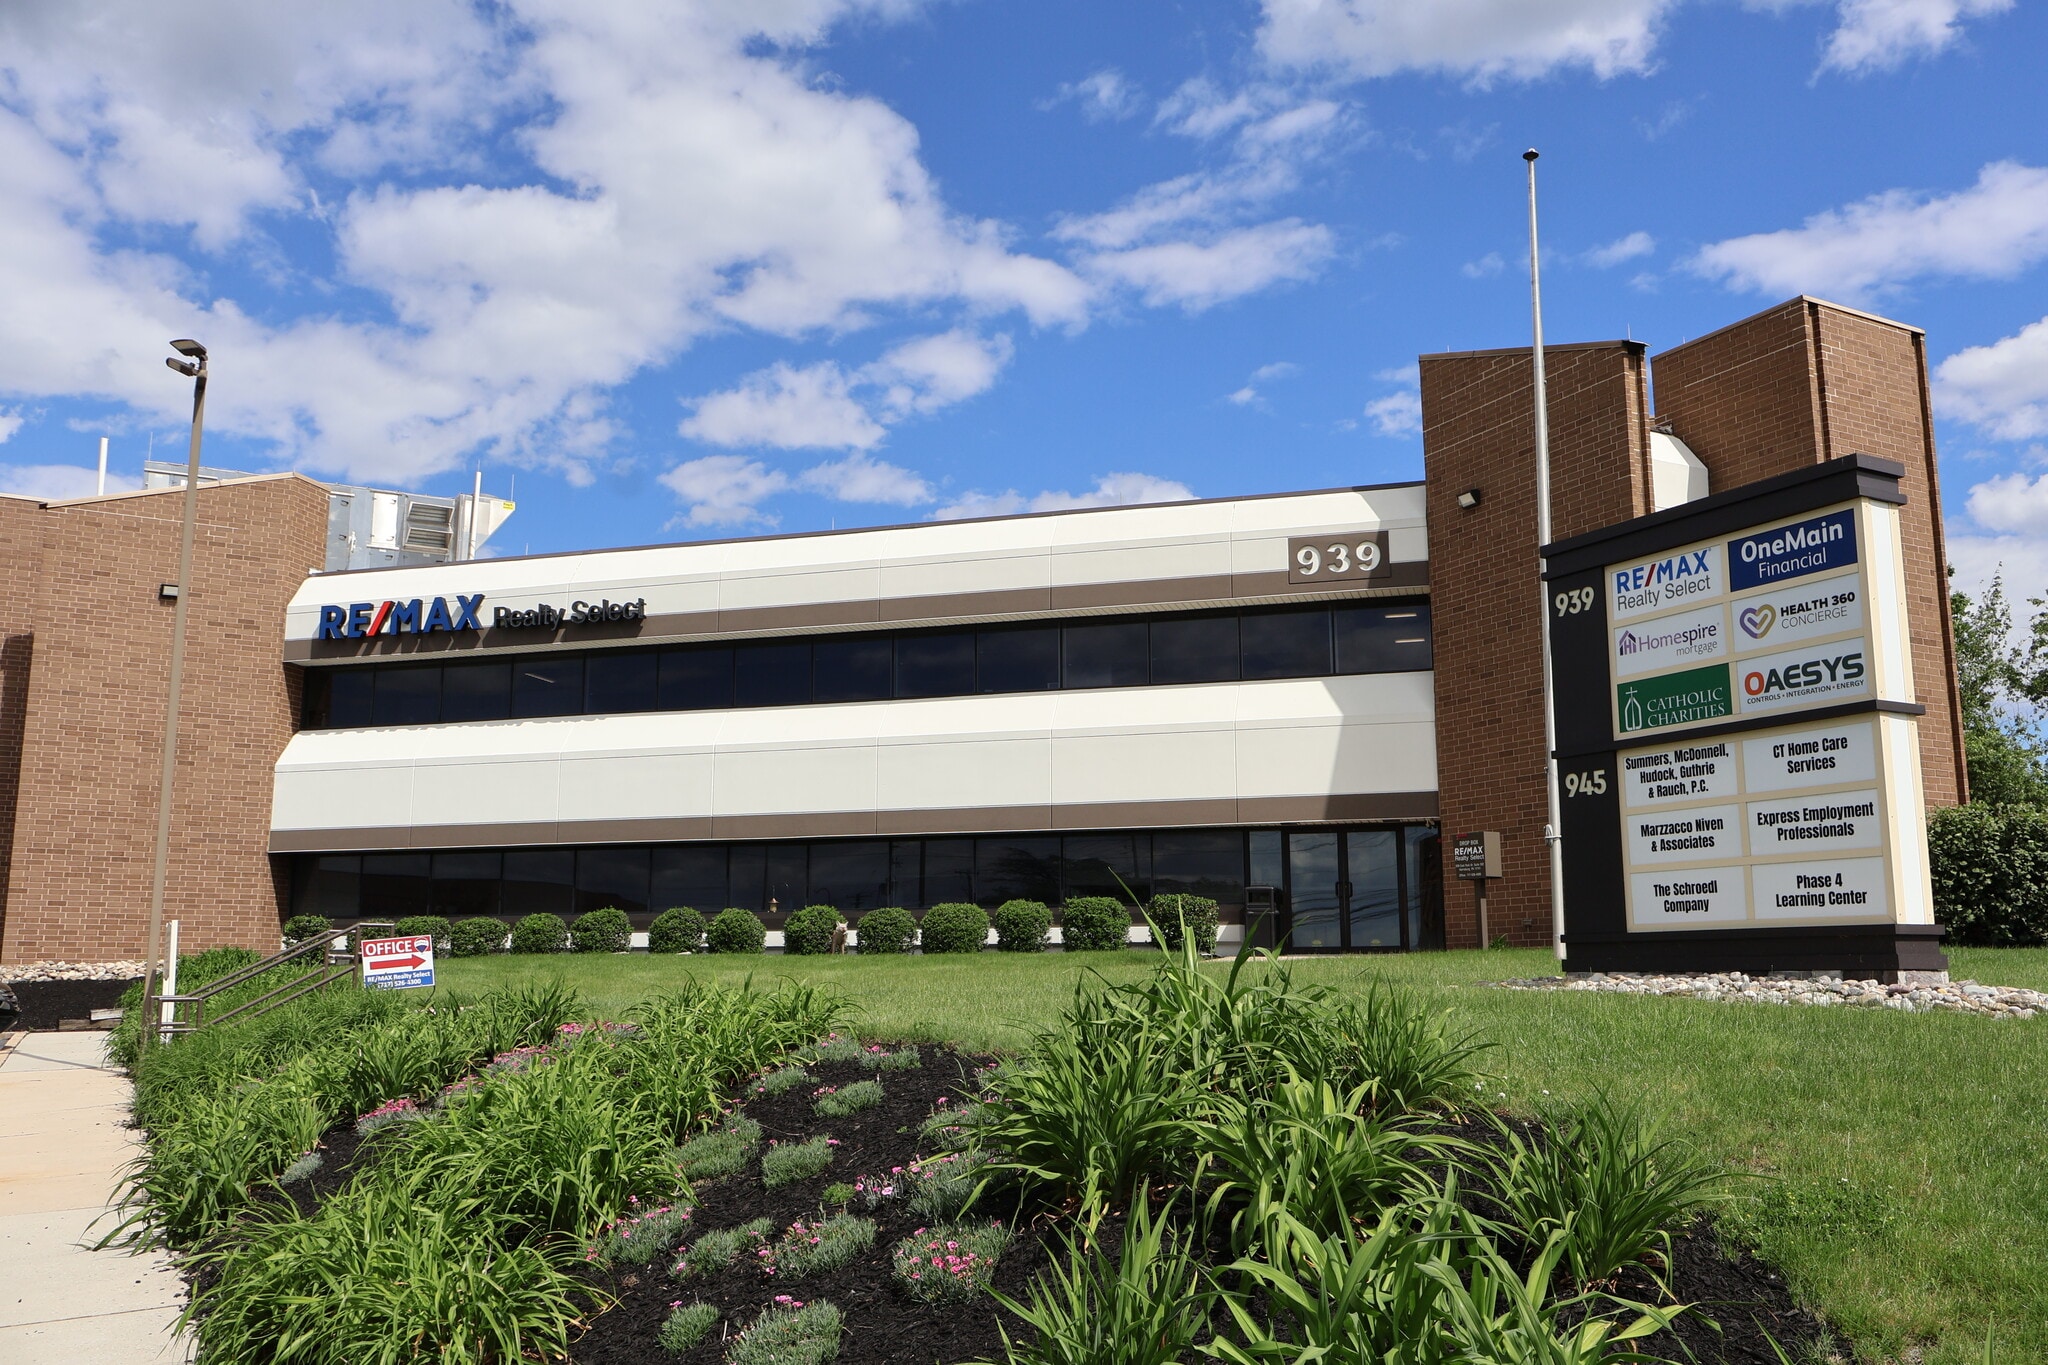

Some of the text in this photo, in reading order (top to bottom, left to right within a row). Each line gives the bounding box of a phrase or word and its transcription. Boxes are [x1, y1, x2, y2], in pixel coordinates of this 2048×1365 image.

[1741, 521, 1843, 563] OneMain
[1296, 540, 1381, 575] 939
[1758, 549, 1827, 579] Financial
[1616, 550, 1710, 594] RE/MAX
[1555, 586, 1595, 617] 939
[1617, 575, 1711, 611] Realty Select
[1780, 591, 1855, 617] HEALTH 360
[320, 593, 647, 640] RE/MAX Realty Select
[1781, 606, 1847, 630] CONCIERGE
[1638, 624, 1717, 652] Homespire
[1676, 639, 1718, 657] mortgage
[1744, 653, 1864, 696] OAESYS
[1647, 687, 1724, 713] CATHOLIC
[1747, 679, 1864, 705] CONTROLS INTEGRATION ENERGY
[1647, 703, 1725, 727] CHARITIES
[1625, 743, 1729, 770] Summers, McDonnell,
[1773, 736, 1849, 759] CT Home Care
[1640, 762, 1715, 785] Hudock, Guthrie
[1787, 756, 1836, 774] Services
[1565, 769, 1607, 798] 945
[1648, 778, 1709, 799] & Rauch, P.C.
[1757, 801, 1875, 828] Express Employment
[1640, 817, 1724, 838] Marzzacco Niven
[1777, 822, 1855, 842] Professionals
[1454, 846, 1483, 855] RE/MAX
[1651, 835, 1715, 852] & Associates
[1653, 879, 1718, 898] The Schroedl
[1796, 872, 1843, 889] Phase 4
[1664, 897, 1710, 914] Company
[1775, 889, 1868, 909] Learning Center
[365, 940, 412, 956] OFFICE
[367, 974, 392, 982] RE/MAX
